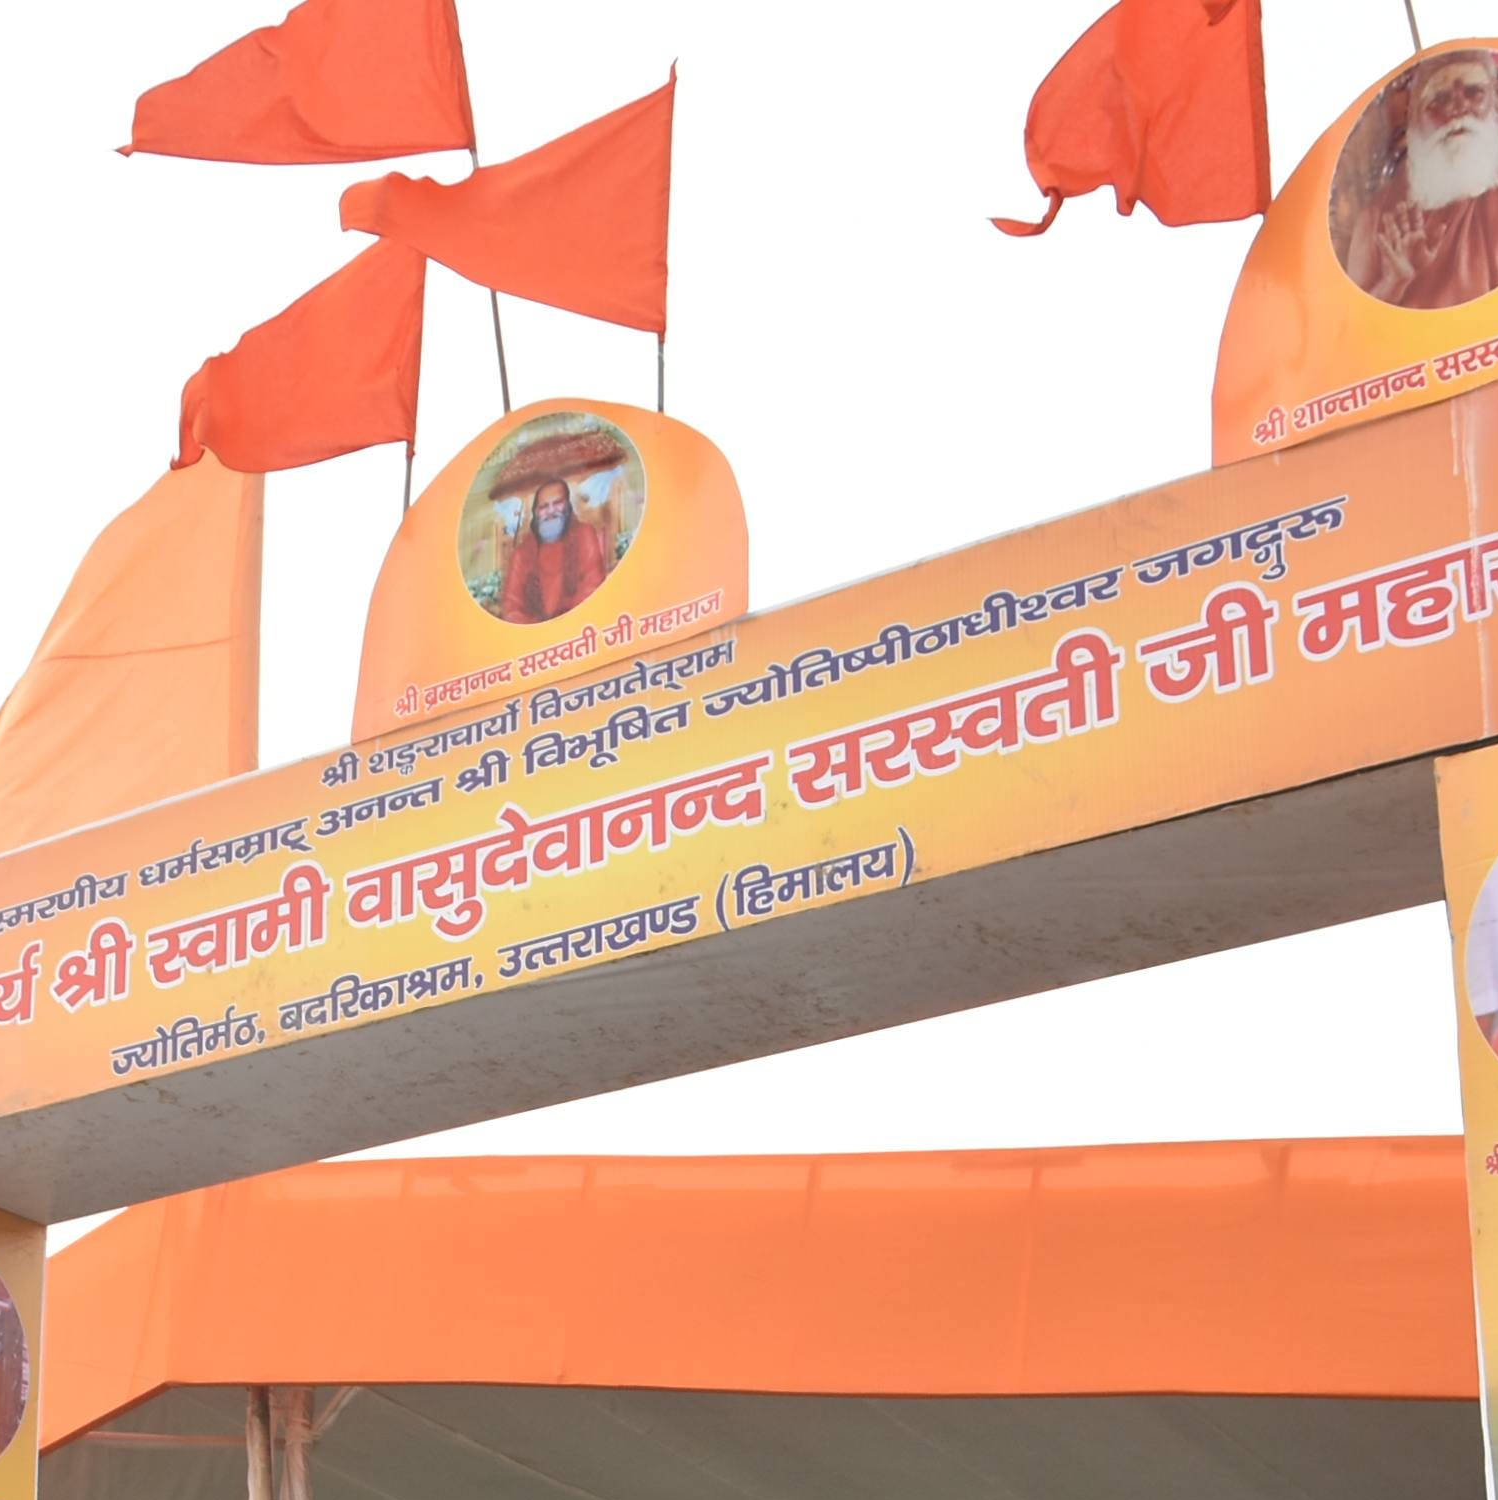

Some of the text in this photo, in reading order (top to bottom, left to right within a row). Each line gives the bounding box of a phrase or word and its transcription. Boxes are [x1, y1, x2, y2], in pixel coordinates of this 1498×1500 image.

[1252, 411, 1285, 446] श्री
[1293, 362, 1426, 431] शान्तानन्द
[395, 686, 418, 716] श्री
[518, 627, 598, 679] सरस्वती
[604, 615, 633, 649] जी
[639, 590, 724, 637] महाराज
[51, 913, 135, 1012] श्री
[147, 862, 331, 991] स्वामी
[347, 752, 771, 938] वासुदेवानन्द
[787, 630, 1124, 810] सरस्वती
[1138, 582, 1278, 703] जी
[139, 812, 315, 888] धर्मसम्राट्
[316, 775, 442, 837] अनन्त
[456, 751, 511, 795] श्री
[525, 700, 692, 770] विभूषित
[704, 566, 1123, 718] ज्योतिष्पीठाधीश्वर
[321, 750, 360, 788] श्री
[496, 893, 700, 981] उत्तराखण्ड
[714, 825, 917, 933] (हिमालय)
